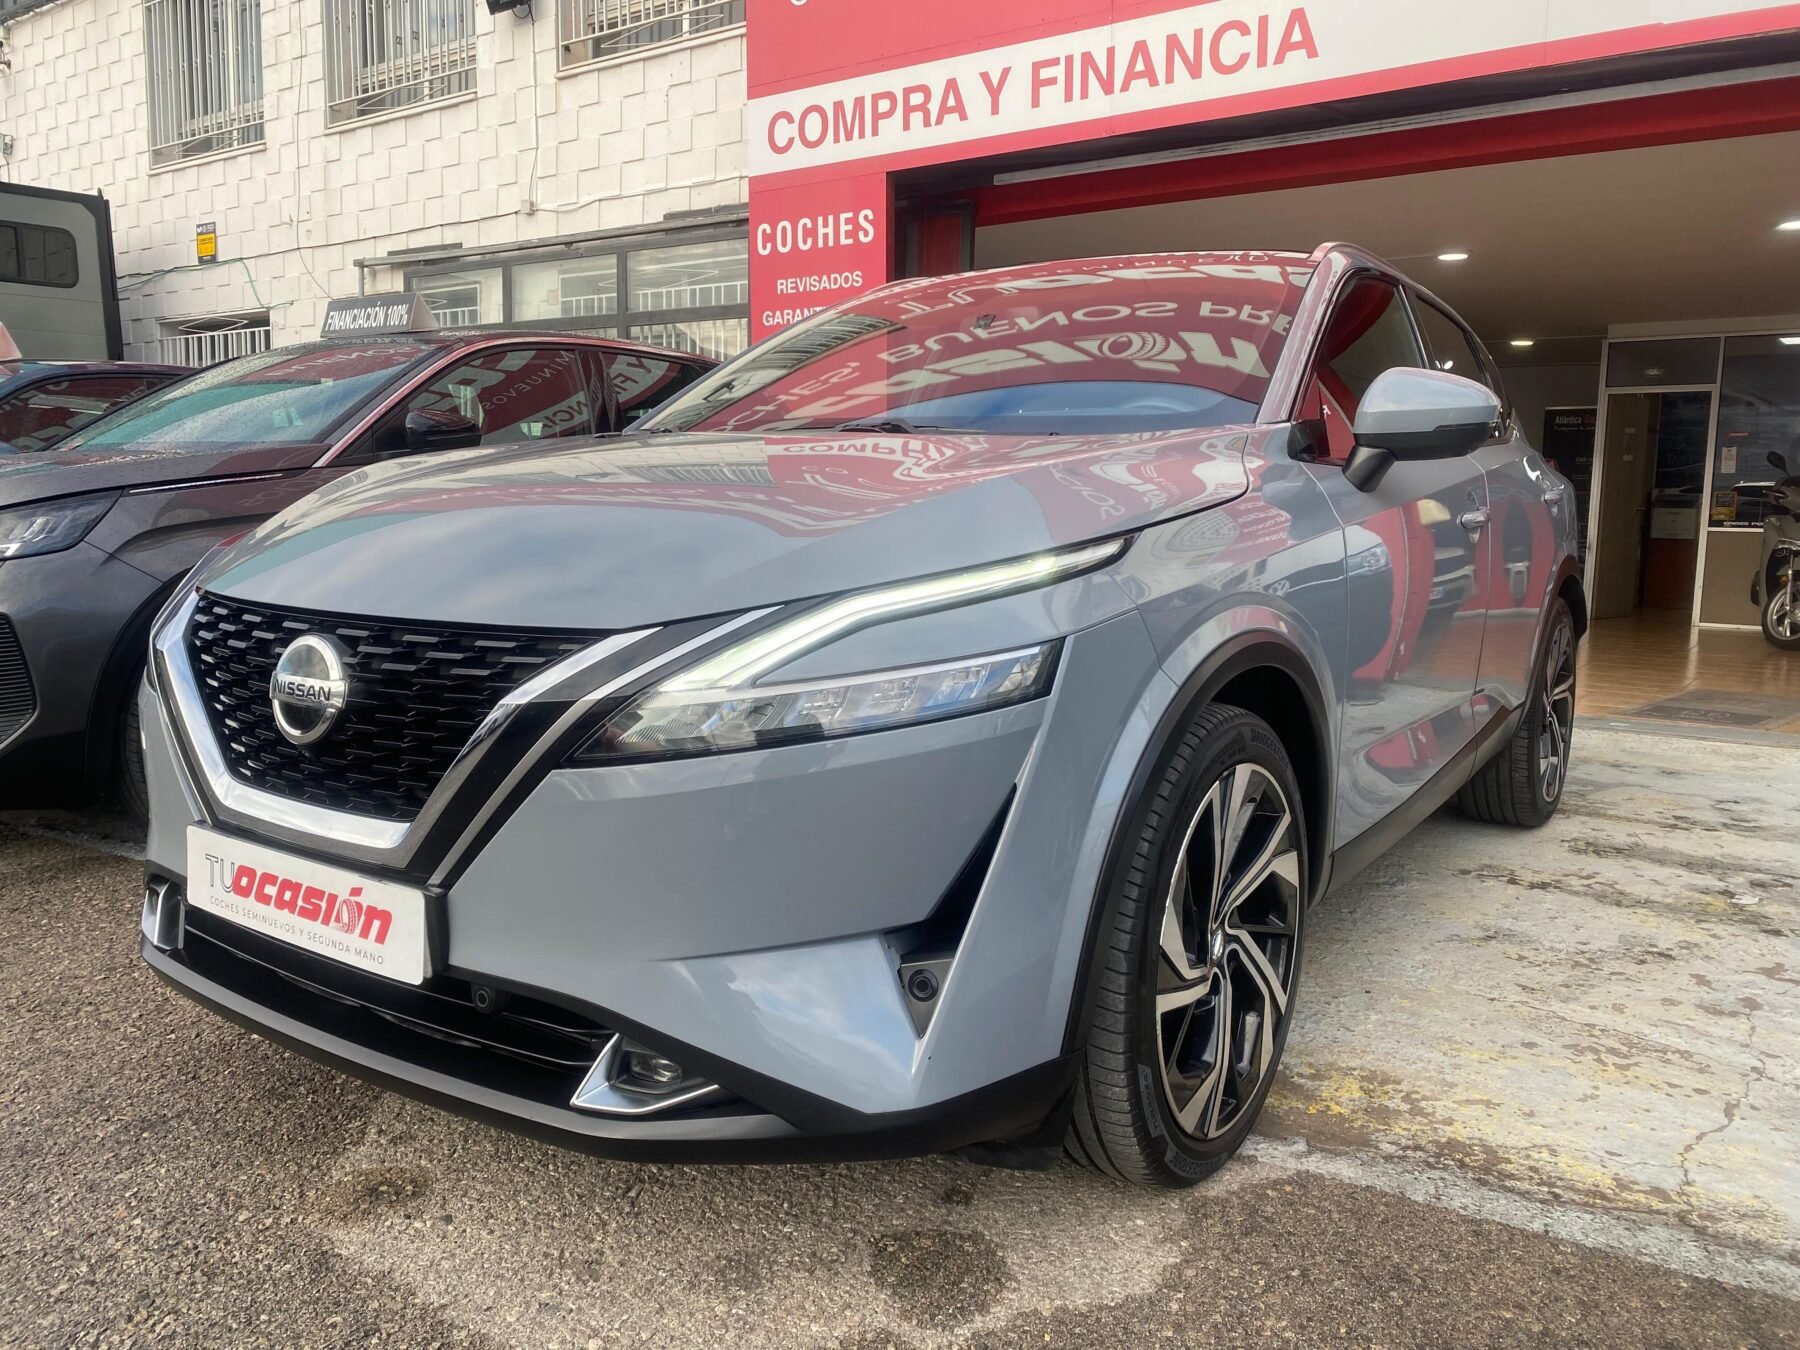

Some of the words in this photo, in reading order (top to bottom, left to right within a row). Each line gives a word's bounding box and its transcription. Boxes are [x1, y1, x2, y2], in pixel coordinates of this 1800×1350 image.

[767, 77, 968, 155] COMPRA
[979, 66, 1012, 117] Y
[1030, 7, 1320, 109] FINANCIA
[757, 209, 874, 256] COCHES
[777, 271, 863, 294] REVISADOS
[325, 301, 387, 331] FINANCIACIÓN
[386, 304, 410, 326] 100%
[273, 679, 331, 702] NISSAN
[209, 895, 240, 914] COCHES
[241, 905, 297, 934] SEMINUEVOS
[298, 927, 305, 937] Y
[306, 927, 351, 952] SEGUNDA
[354, 948, 385, 965] MANO
